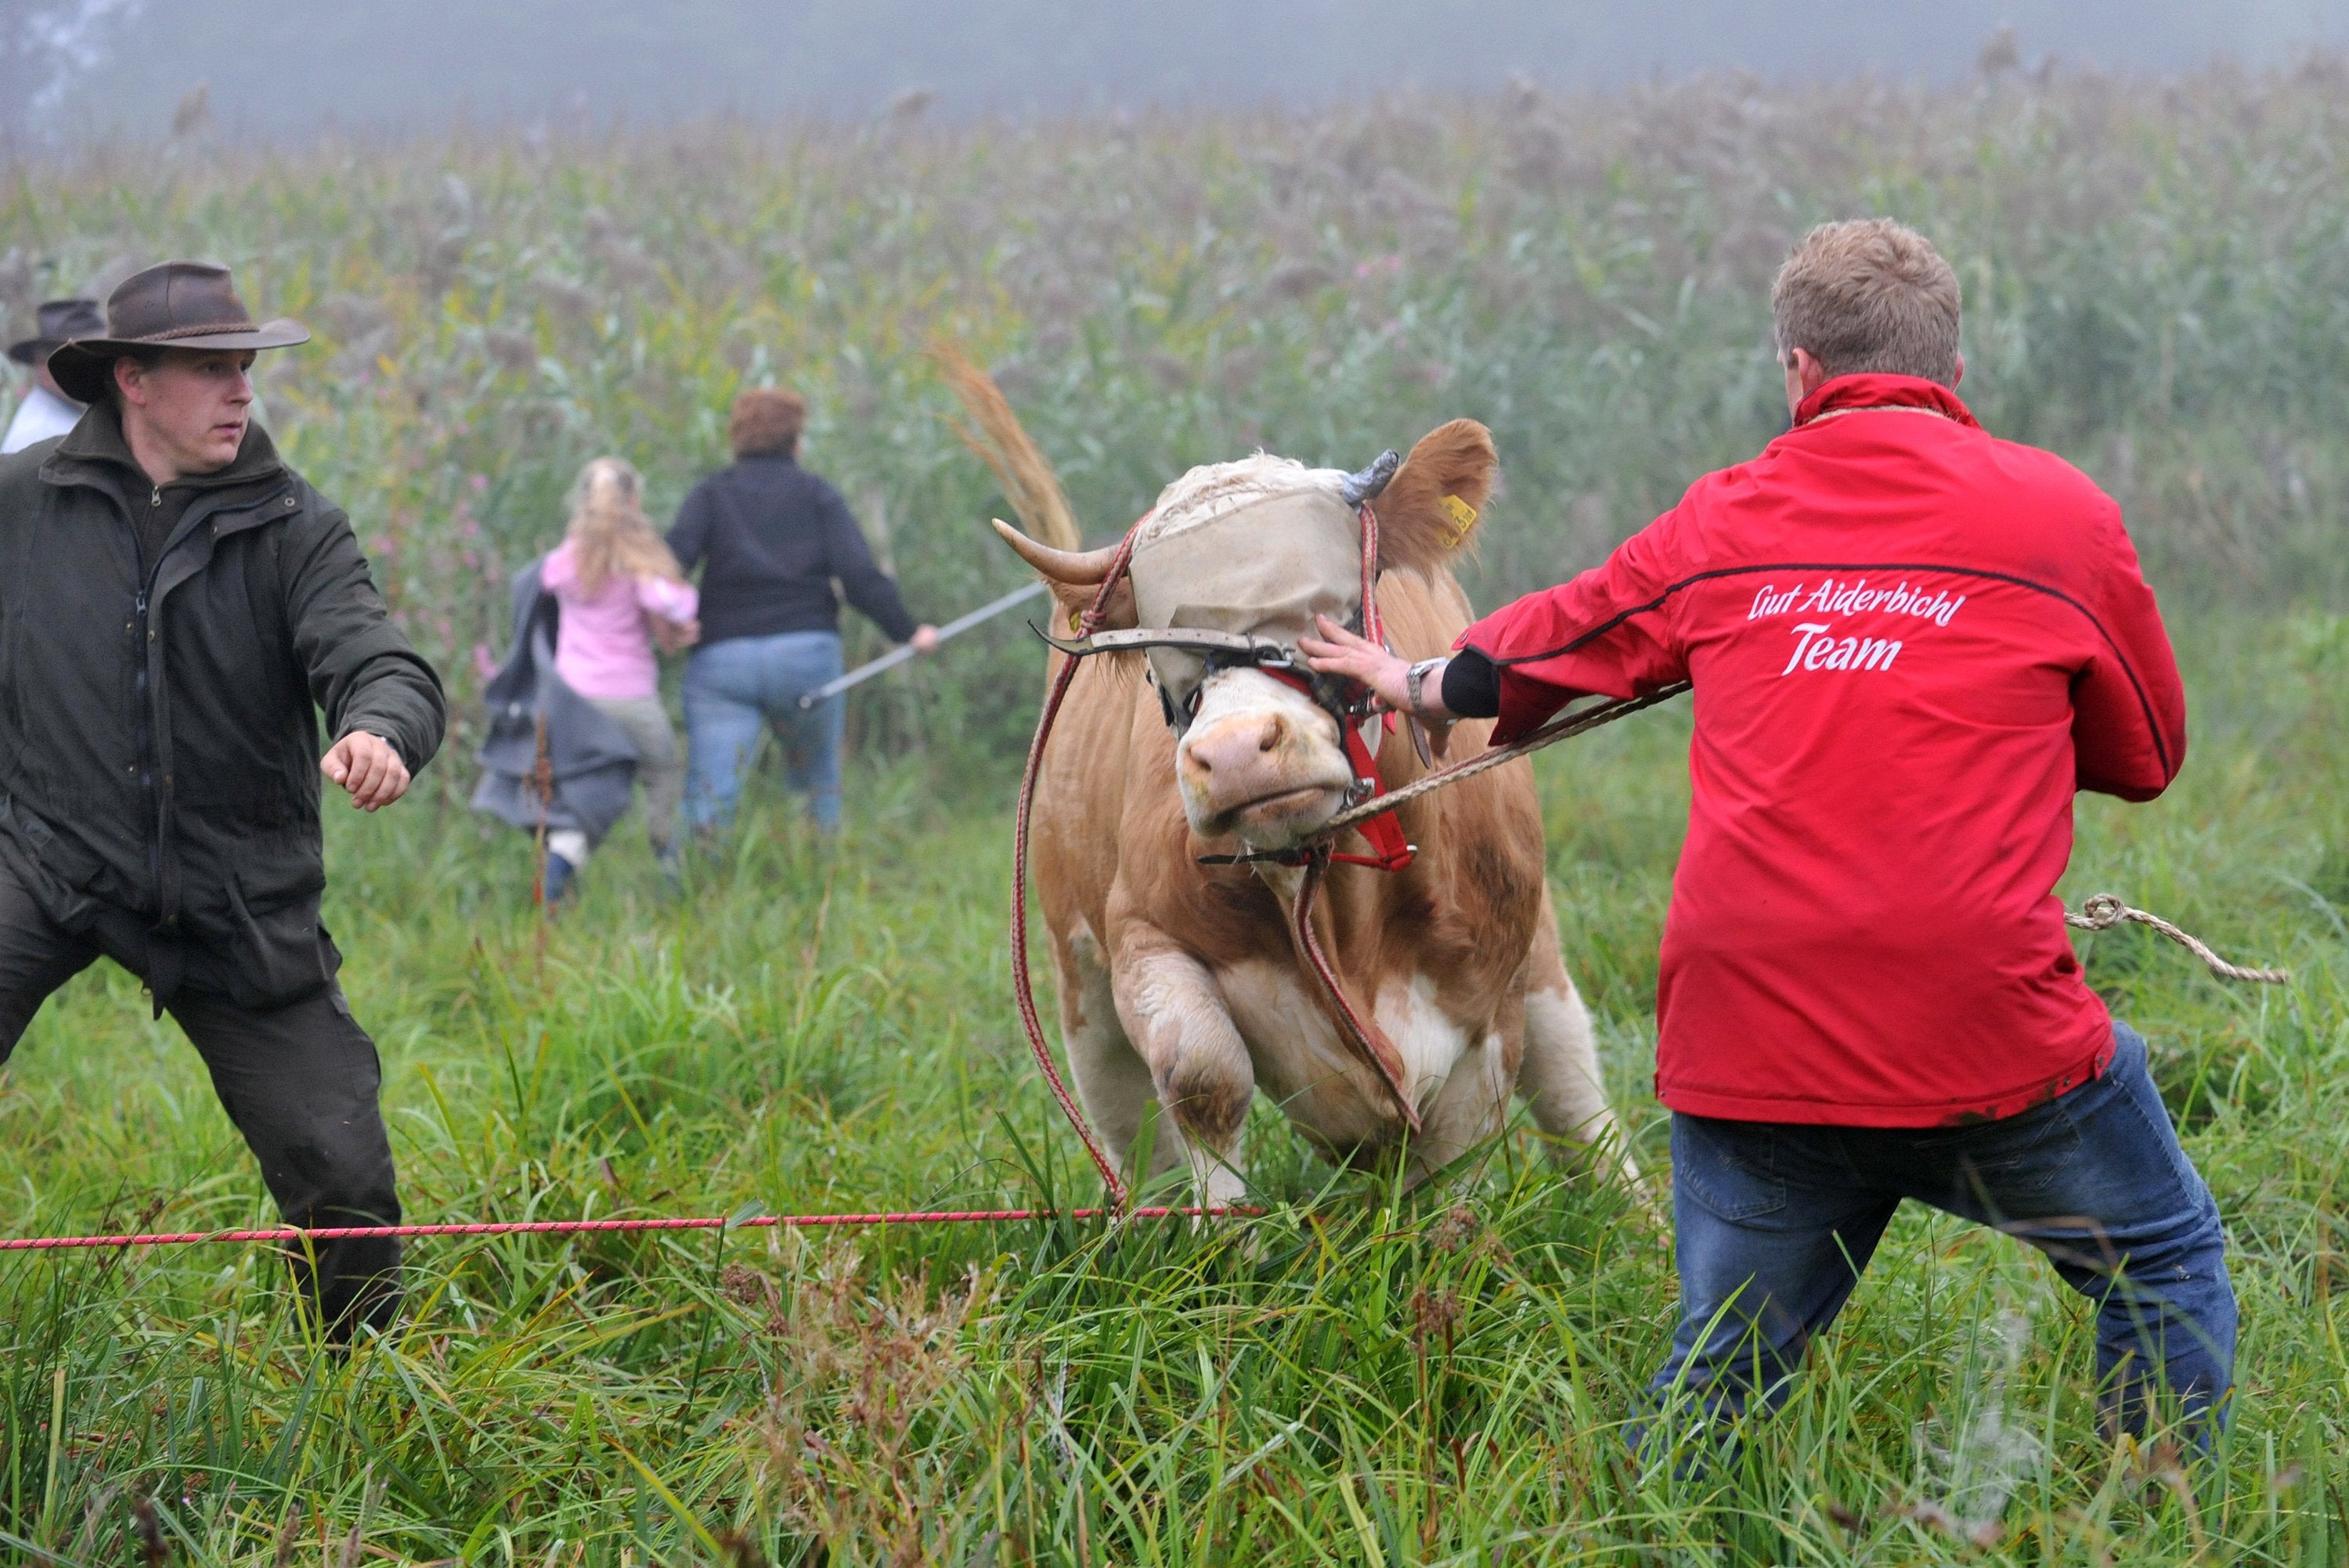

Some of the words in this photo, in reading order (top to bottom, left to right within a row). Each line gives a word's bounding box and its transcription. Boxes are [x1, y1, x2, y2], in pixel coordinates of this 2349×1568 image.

[1747, 583, 1803, 621] Gut
[1797, 578, 1966, 627] Aiderbichl
[1781, 622, 1903, 676] Team
